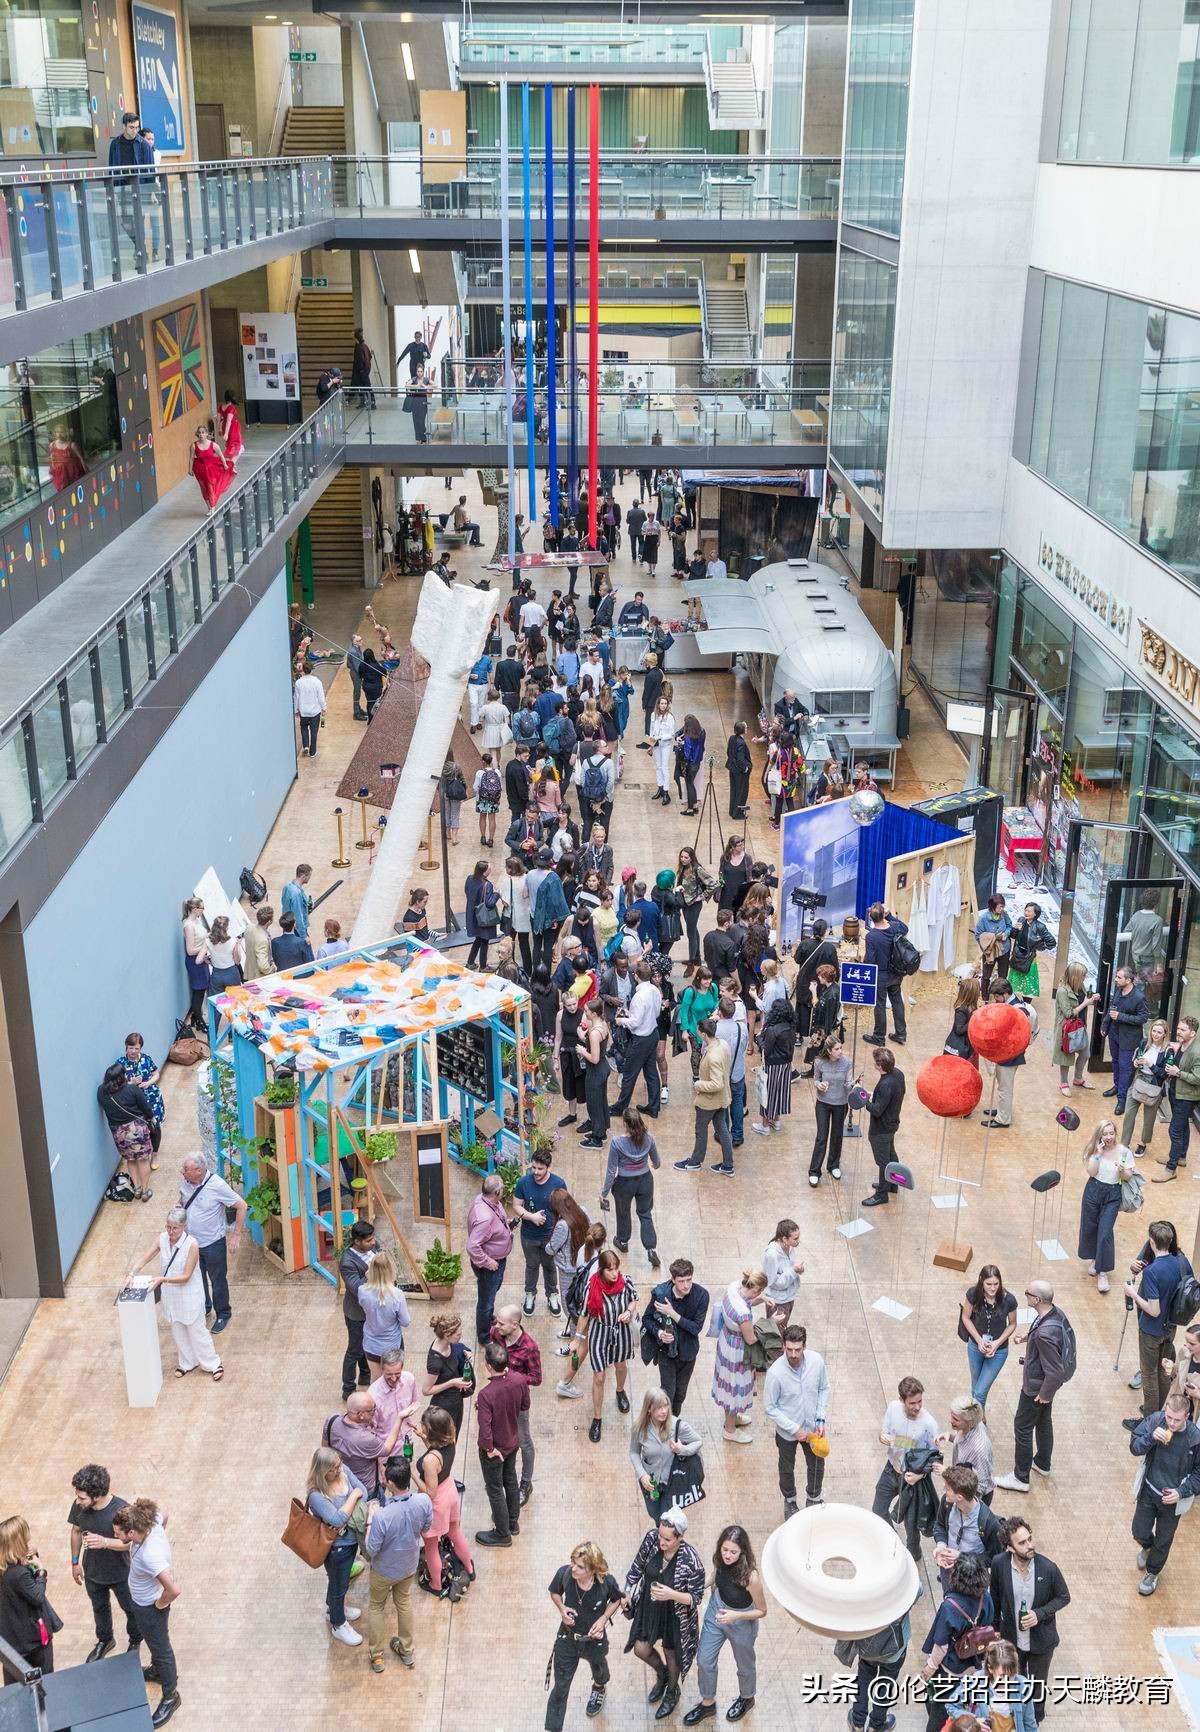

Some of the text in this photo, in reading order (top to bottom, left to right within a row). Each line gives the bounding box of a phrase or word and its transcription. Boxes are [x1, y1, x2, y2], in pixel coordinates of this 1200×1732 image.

[136, 16, 165, 51] Bletchley
[140, 56, 157, 92] A50
[672, 1484, 703, 1508] ual:
